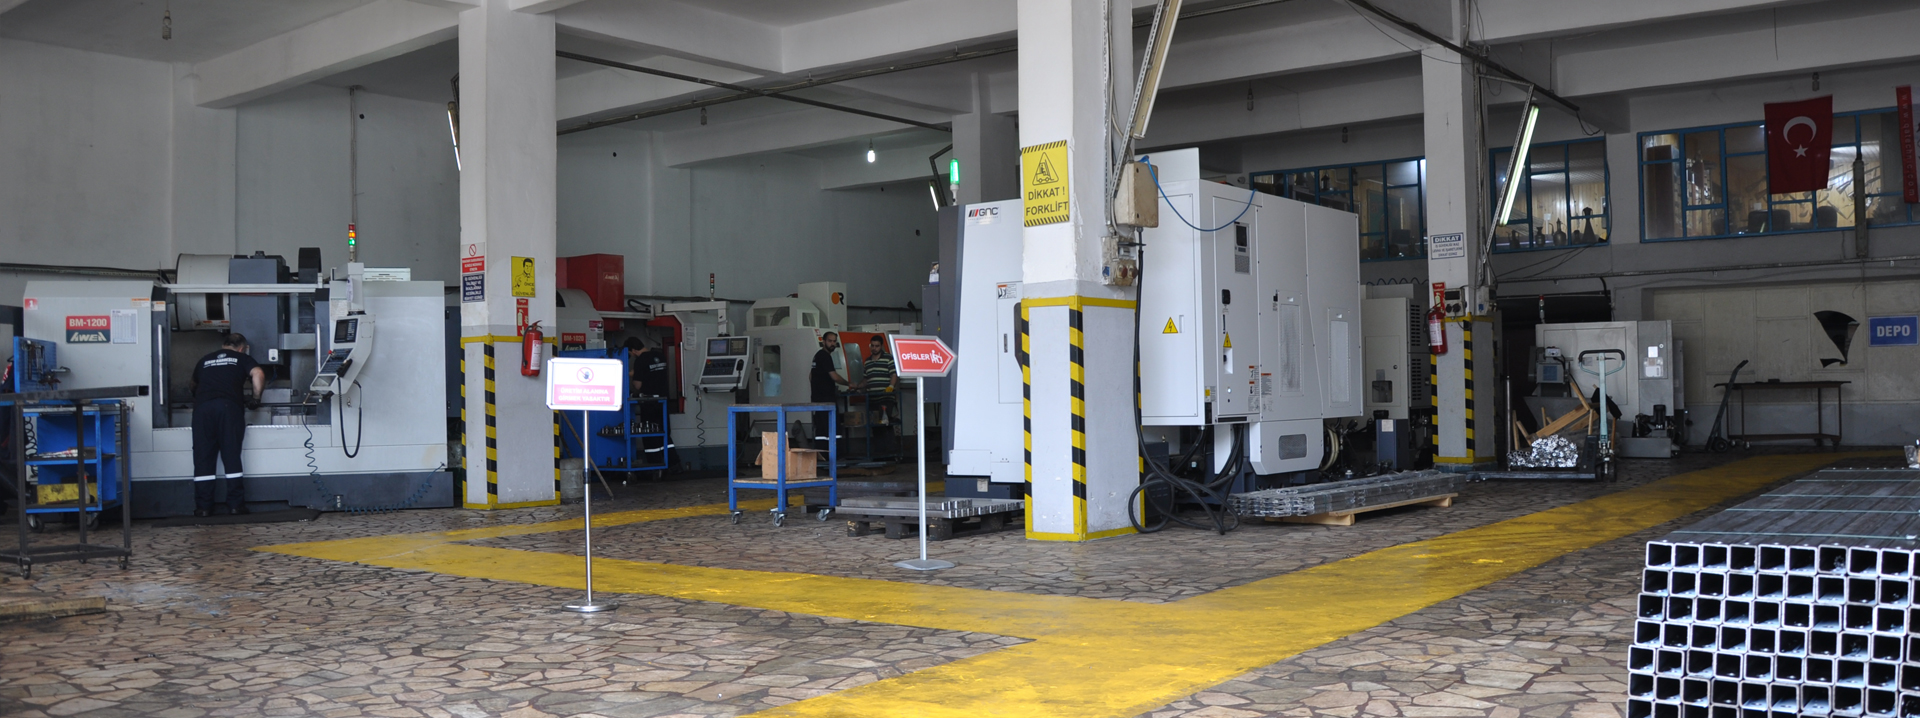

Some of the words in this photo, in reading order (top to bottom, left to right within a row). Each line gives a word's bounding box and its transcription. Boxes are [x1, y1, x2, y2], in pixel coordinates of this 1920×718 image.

[1028, 187, 1060, 201] DİKKAT
[978, 206, 999, 217] GNC
[1026, 201, 1069, 216] FORKLİFT
[1434, 235, 1460, 243] DİKKAT
[69, 318, 107, 327] BM-1200
[1876, 324, 1911, 338] DEPO
[901, 351, 931, 361] OFİSLER
